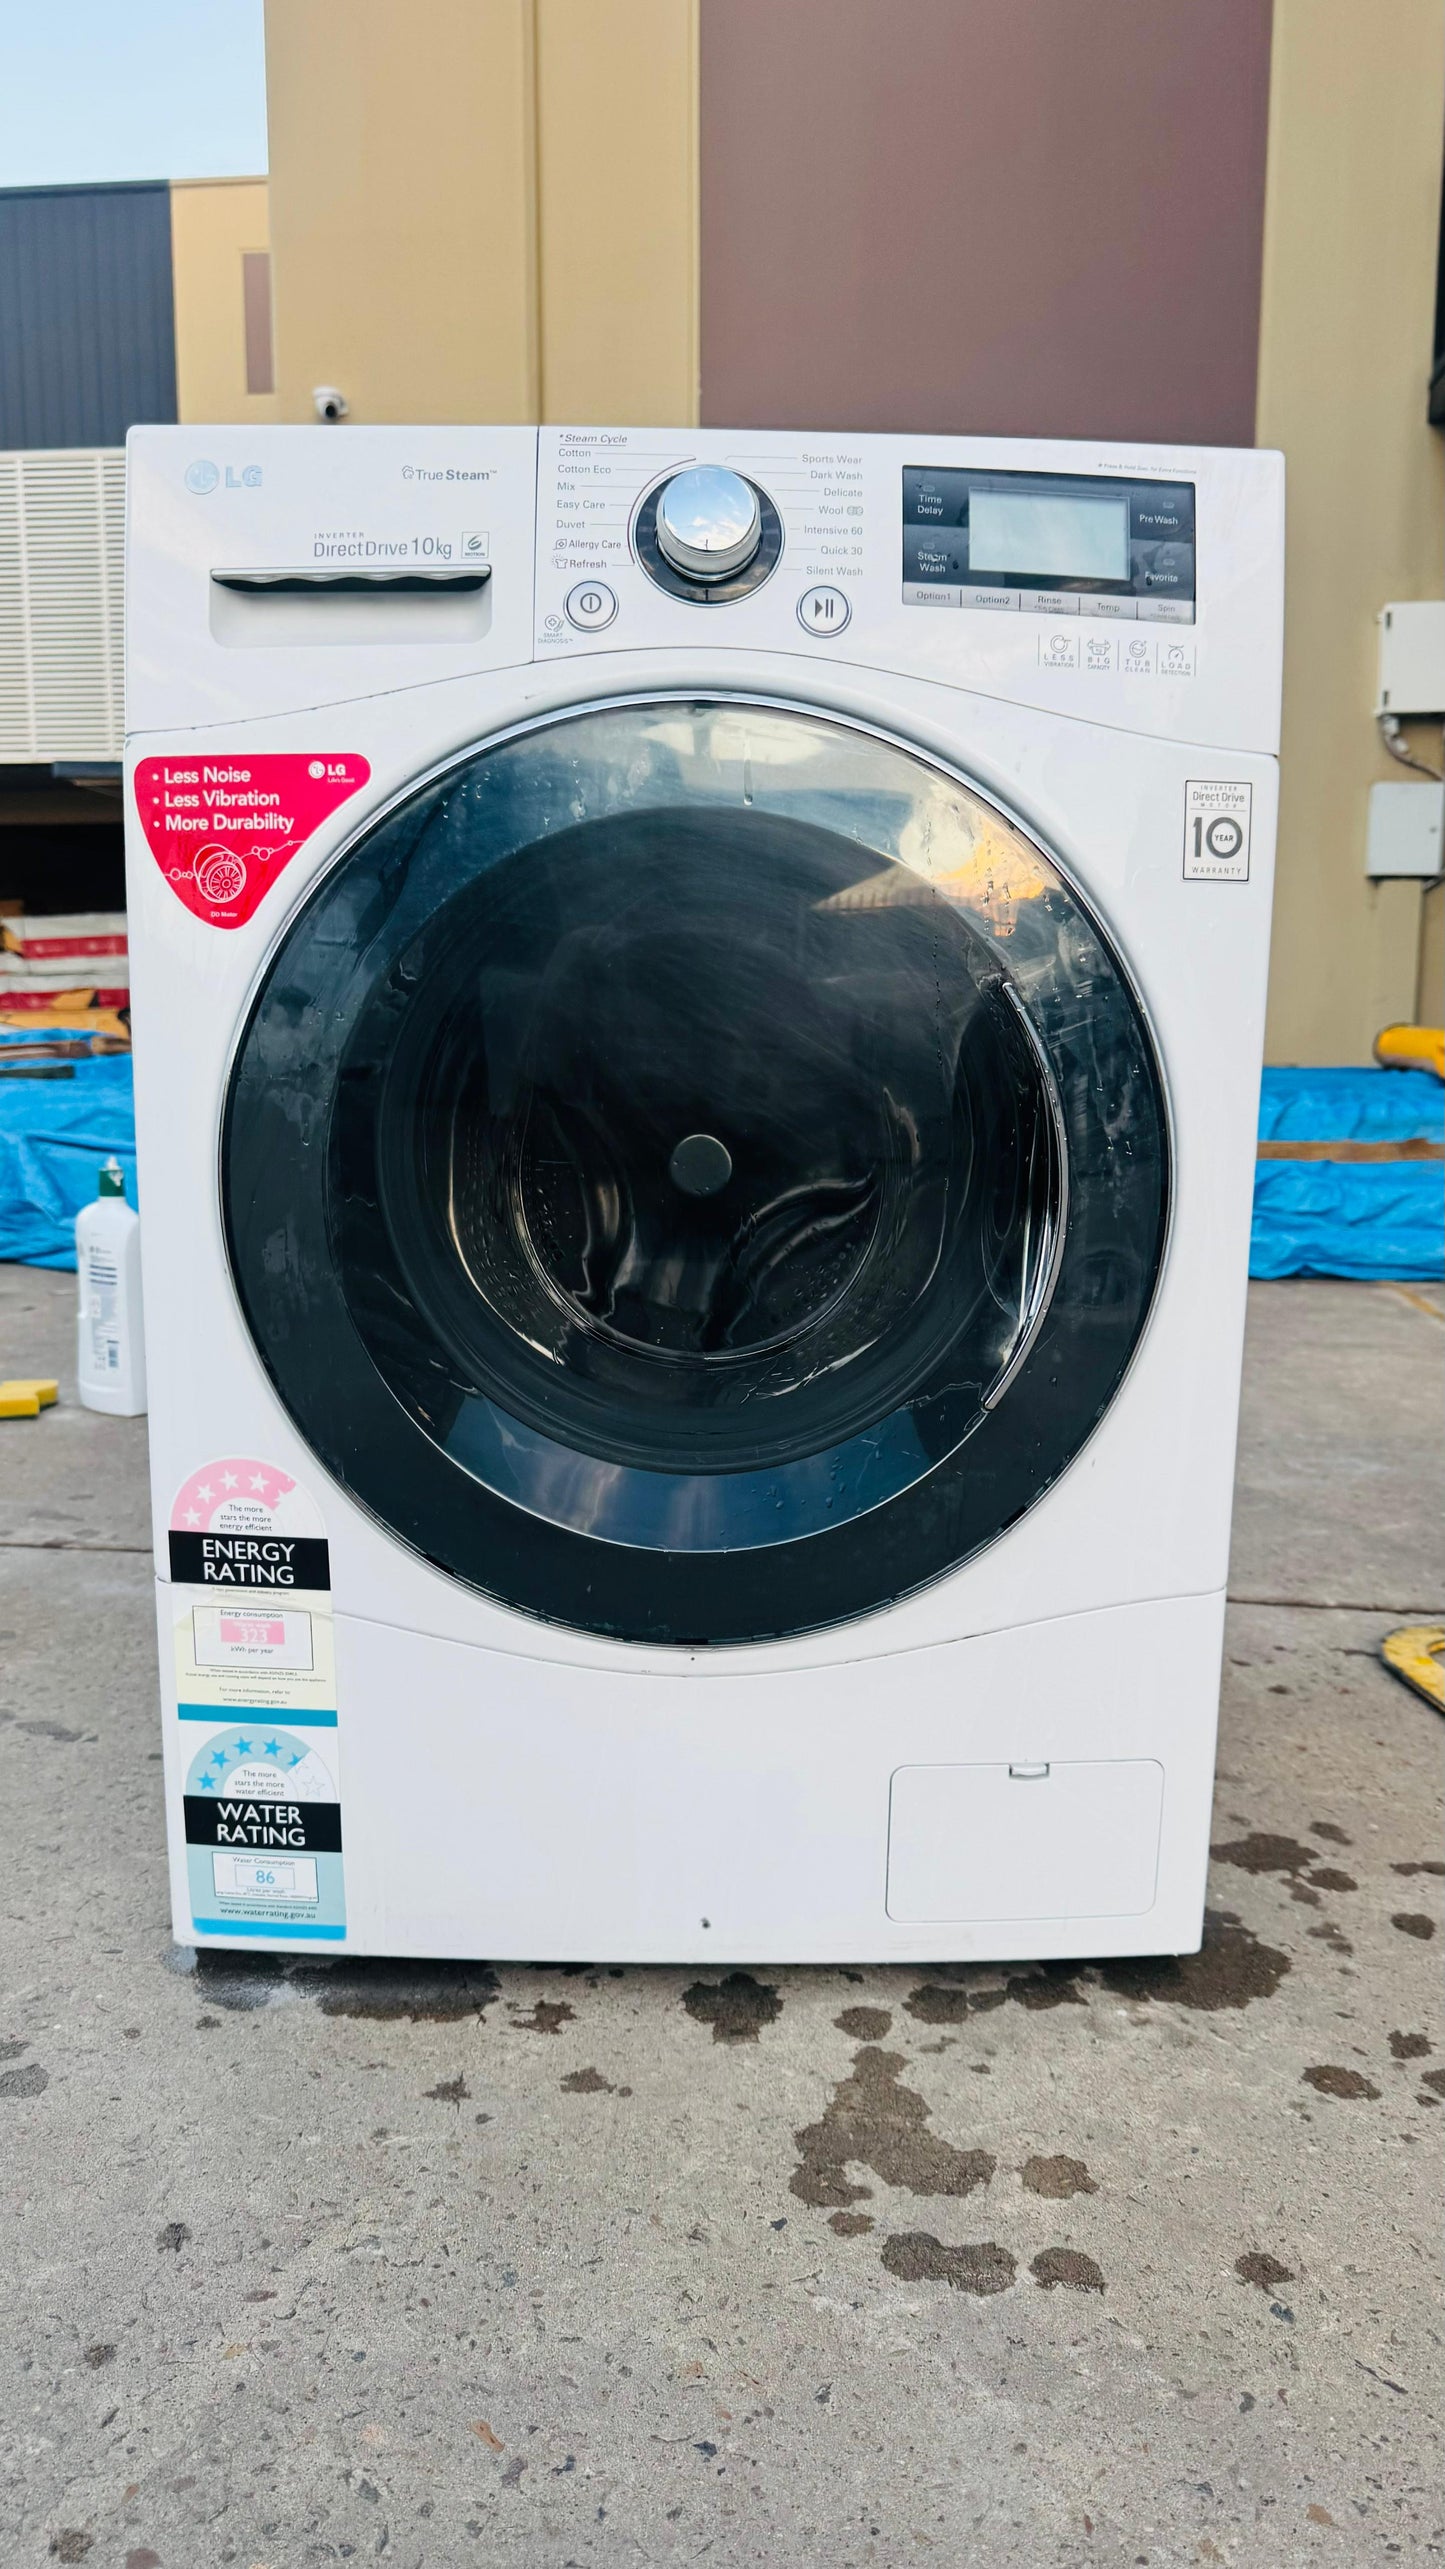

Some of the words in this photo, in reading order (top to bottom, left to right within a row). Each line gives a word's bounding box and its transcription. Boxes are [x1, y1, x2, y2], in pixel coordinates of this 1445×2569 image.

[600, 434, 628, 444] Cycle
[558, 448, 592, 457] Cotton
[802, 454, 834, 464] Sports
[836, 455, 862, 464] Wear
[558, 465, 590, 474] Cotton
[594, 466, 612, 474] Eco
[225, 464, 263, 488] LG
[810, 470, 832, 480] Dark
[836, 471, 863, 480] Wash
[557, 482, 576, 490] Mix
[824, 488, 863, 498] Delicate
[919, 494, 942, 504] Time
[556, 500, 580, 510] Easy
[583, 500, 606, 509] Care
[818, 505, 844, 514] Wool
[917, 505, 944, 516] Delay
[556, 520, 585, 528] Duvet
[1140, 514, 1153, 524] Pre
[1154, 514, 1178, 524] Wash
[804, 524, 848, 534] Intensive
[851, 526, 863, 536] 60
[568, 540, 600, 550] Allergy
[602, 540, 622, 549] Care
[820, 545, 848, 555] Quick
[850, 546, 863, 556] 30
[569, 560, 607, 568] Refresh
[920, 563, 946, 572] Wash
[806, 566, 834, 576] Silent
[836, 567, 863, 576] Wash
[1144, 570, 1178, 583] Favorite
[916, 591, 951, 601] Option1
[976, 594, 1010, 604] Option2
[1038, 596, 1062, 604] Rinse
[1097, 602, 1120, 612] Temp
[1158, 604, 1176, 613] Spin
[1044, 653, 1074, 662] LESS
[1088, 656, 1110, 664] BIG
[1126, 658, 1150, 667] TUB
[1124, 666, 1150, 674] CLEAN
[1161, 662, 1191, 670] LOAD
[164, 767, 199, 784] Less
[204, 766, 252, 782] Noise
[328, 764, 346, 776] LG
[1200, 784, 1237, 792] INVERTER
[164, 790, 200, 808] Less
[203, 790, 280, 806] Vibration
[1192, 791, 1219, 802] Direct
[1222, 792, 1245, 802] Drive
[165, 814, 210, 831] More
[213, 812, 294, 834] Durability
[1192, 816, 1243, 859] 10
[1214, 834, 1234, 842] YEAR
[1192, 866, 1242, 875] WARRANTY
[230, 1504, 242, 1512] The
[239, 1514, 250, 1522] the
[220, 1523, 243, 1532] energy
[244, 1523, 272, 1532] efficient
[202, 1539, 296, 1562] ENERGY
[203, 1562, 294, 1585] RATING
[220, 1610, 242, 1618] Energy
[240, 1629, 268, 1643] 323
[217, 1802, 303, 1824] WATER
[217, 1824, 306, 1846] RATING
[254, 1857, 296, 1866] Consumption
[256, 1870, 276, 1884] 86
[220, 1908, 316, 1920] www.waterrating.gov.au
